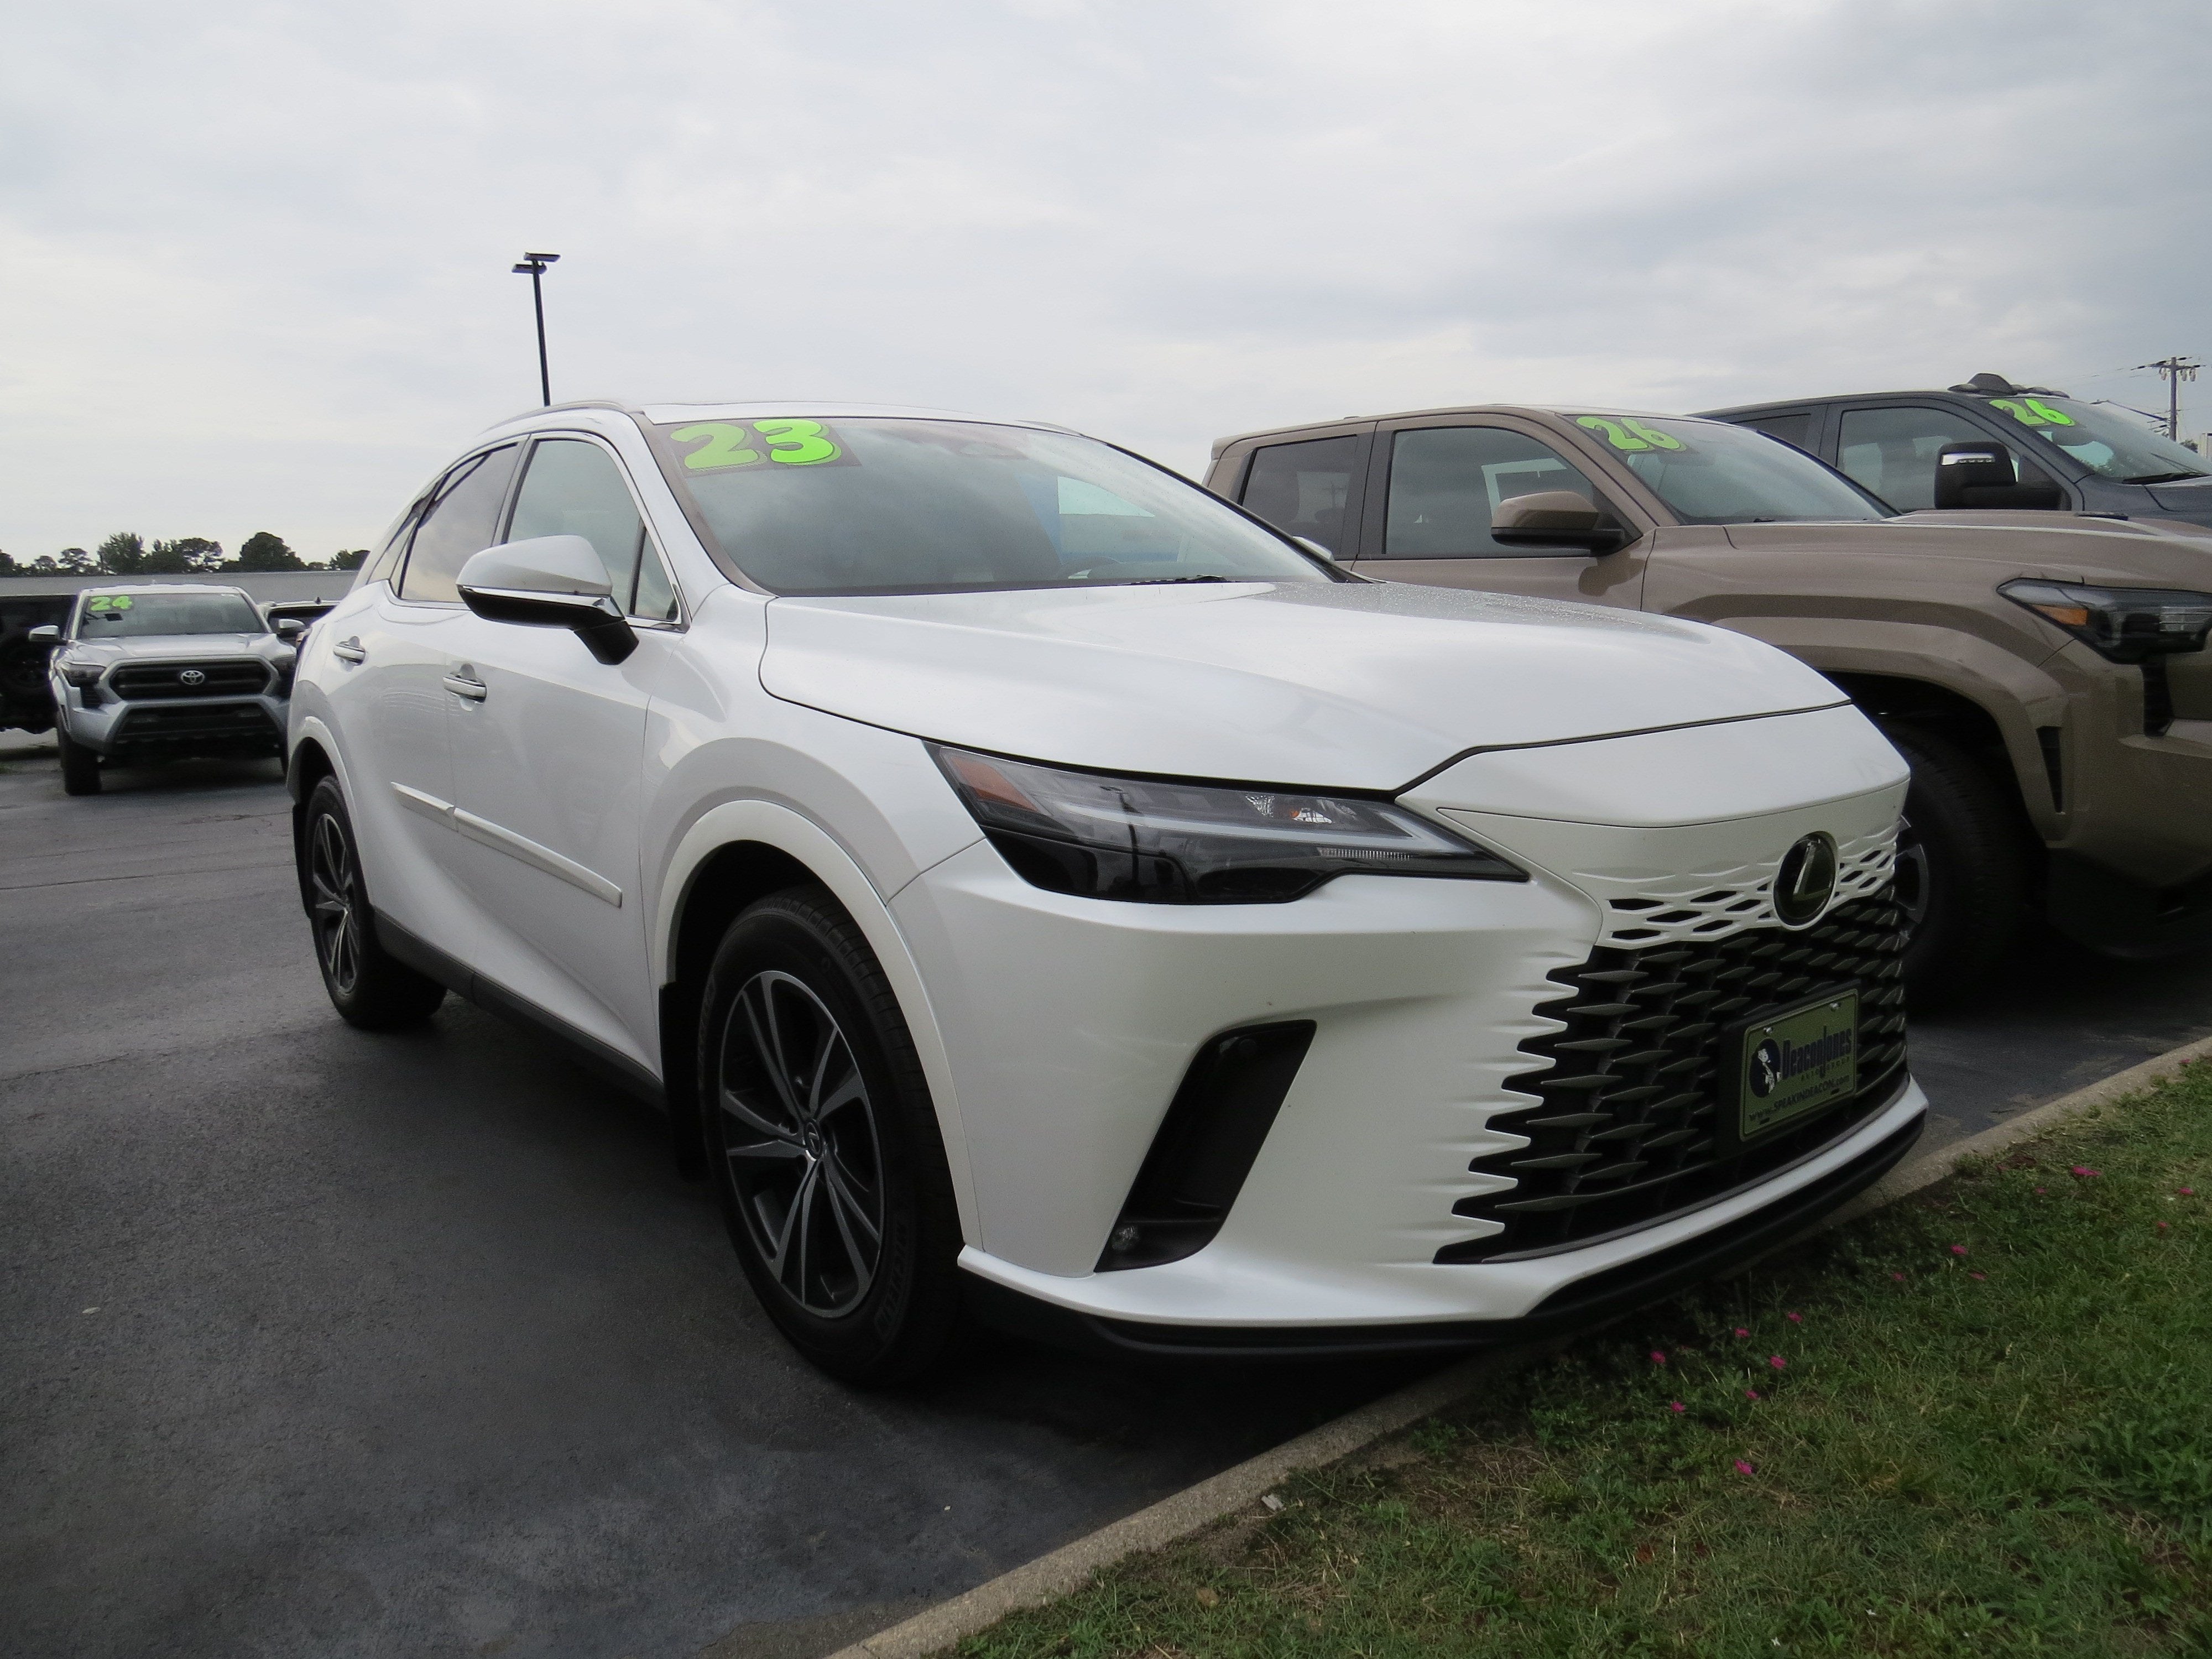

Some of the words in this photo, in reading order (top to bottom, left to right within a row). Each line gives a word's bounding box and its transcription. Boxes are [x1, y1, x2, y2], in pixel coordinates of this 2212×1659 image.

[1989, 398, 2076, 426] 26
[670, 419, 842, 472] 23
[1576, 416, 1687, 451] 26
[90, 596, 133, 612] 24
